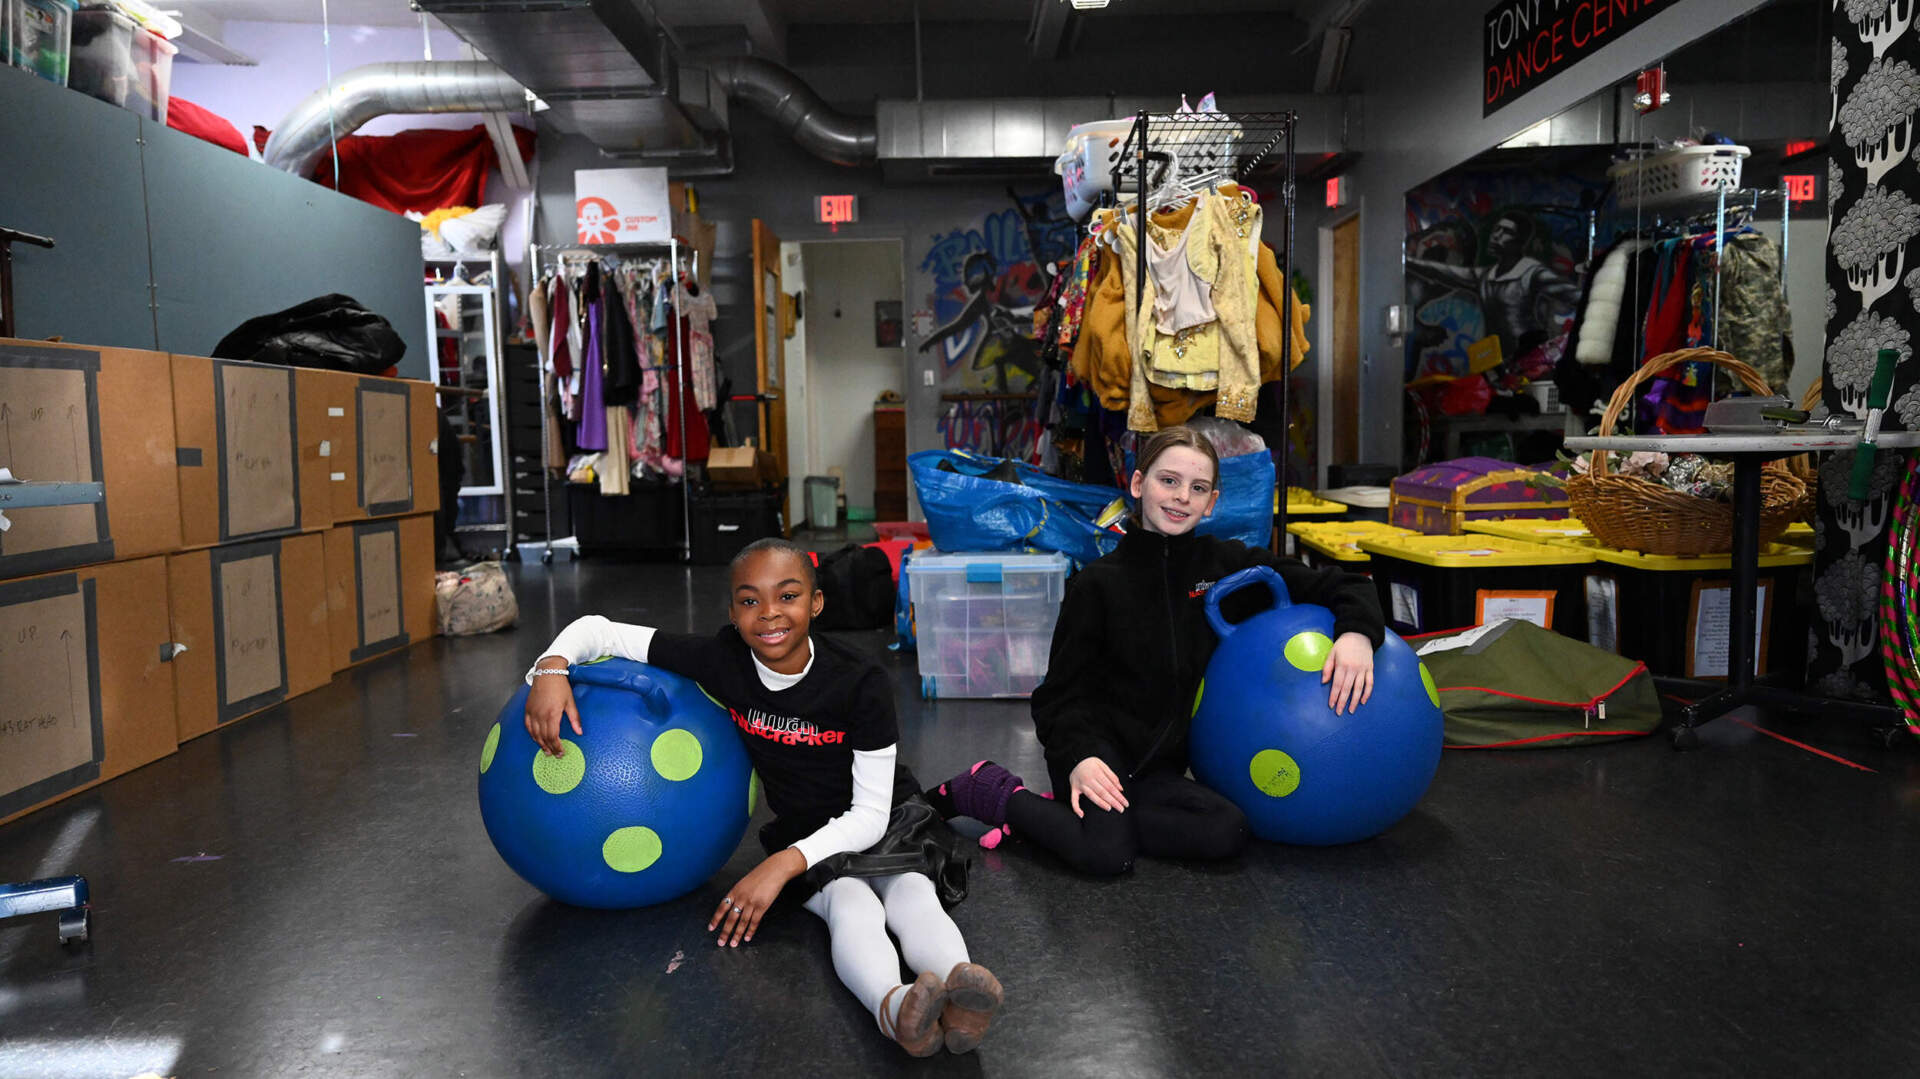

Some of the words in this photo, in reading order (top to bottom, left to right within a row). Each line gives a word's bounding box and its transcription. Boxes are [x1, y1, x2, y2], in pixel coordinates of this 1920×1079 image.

[1489, 0, 1541, 56] TONY
[1487, 19, 1564, 104] DANCE
[820, 195, 854, 222] EXIT
